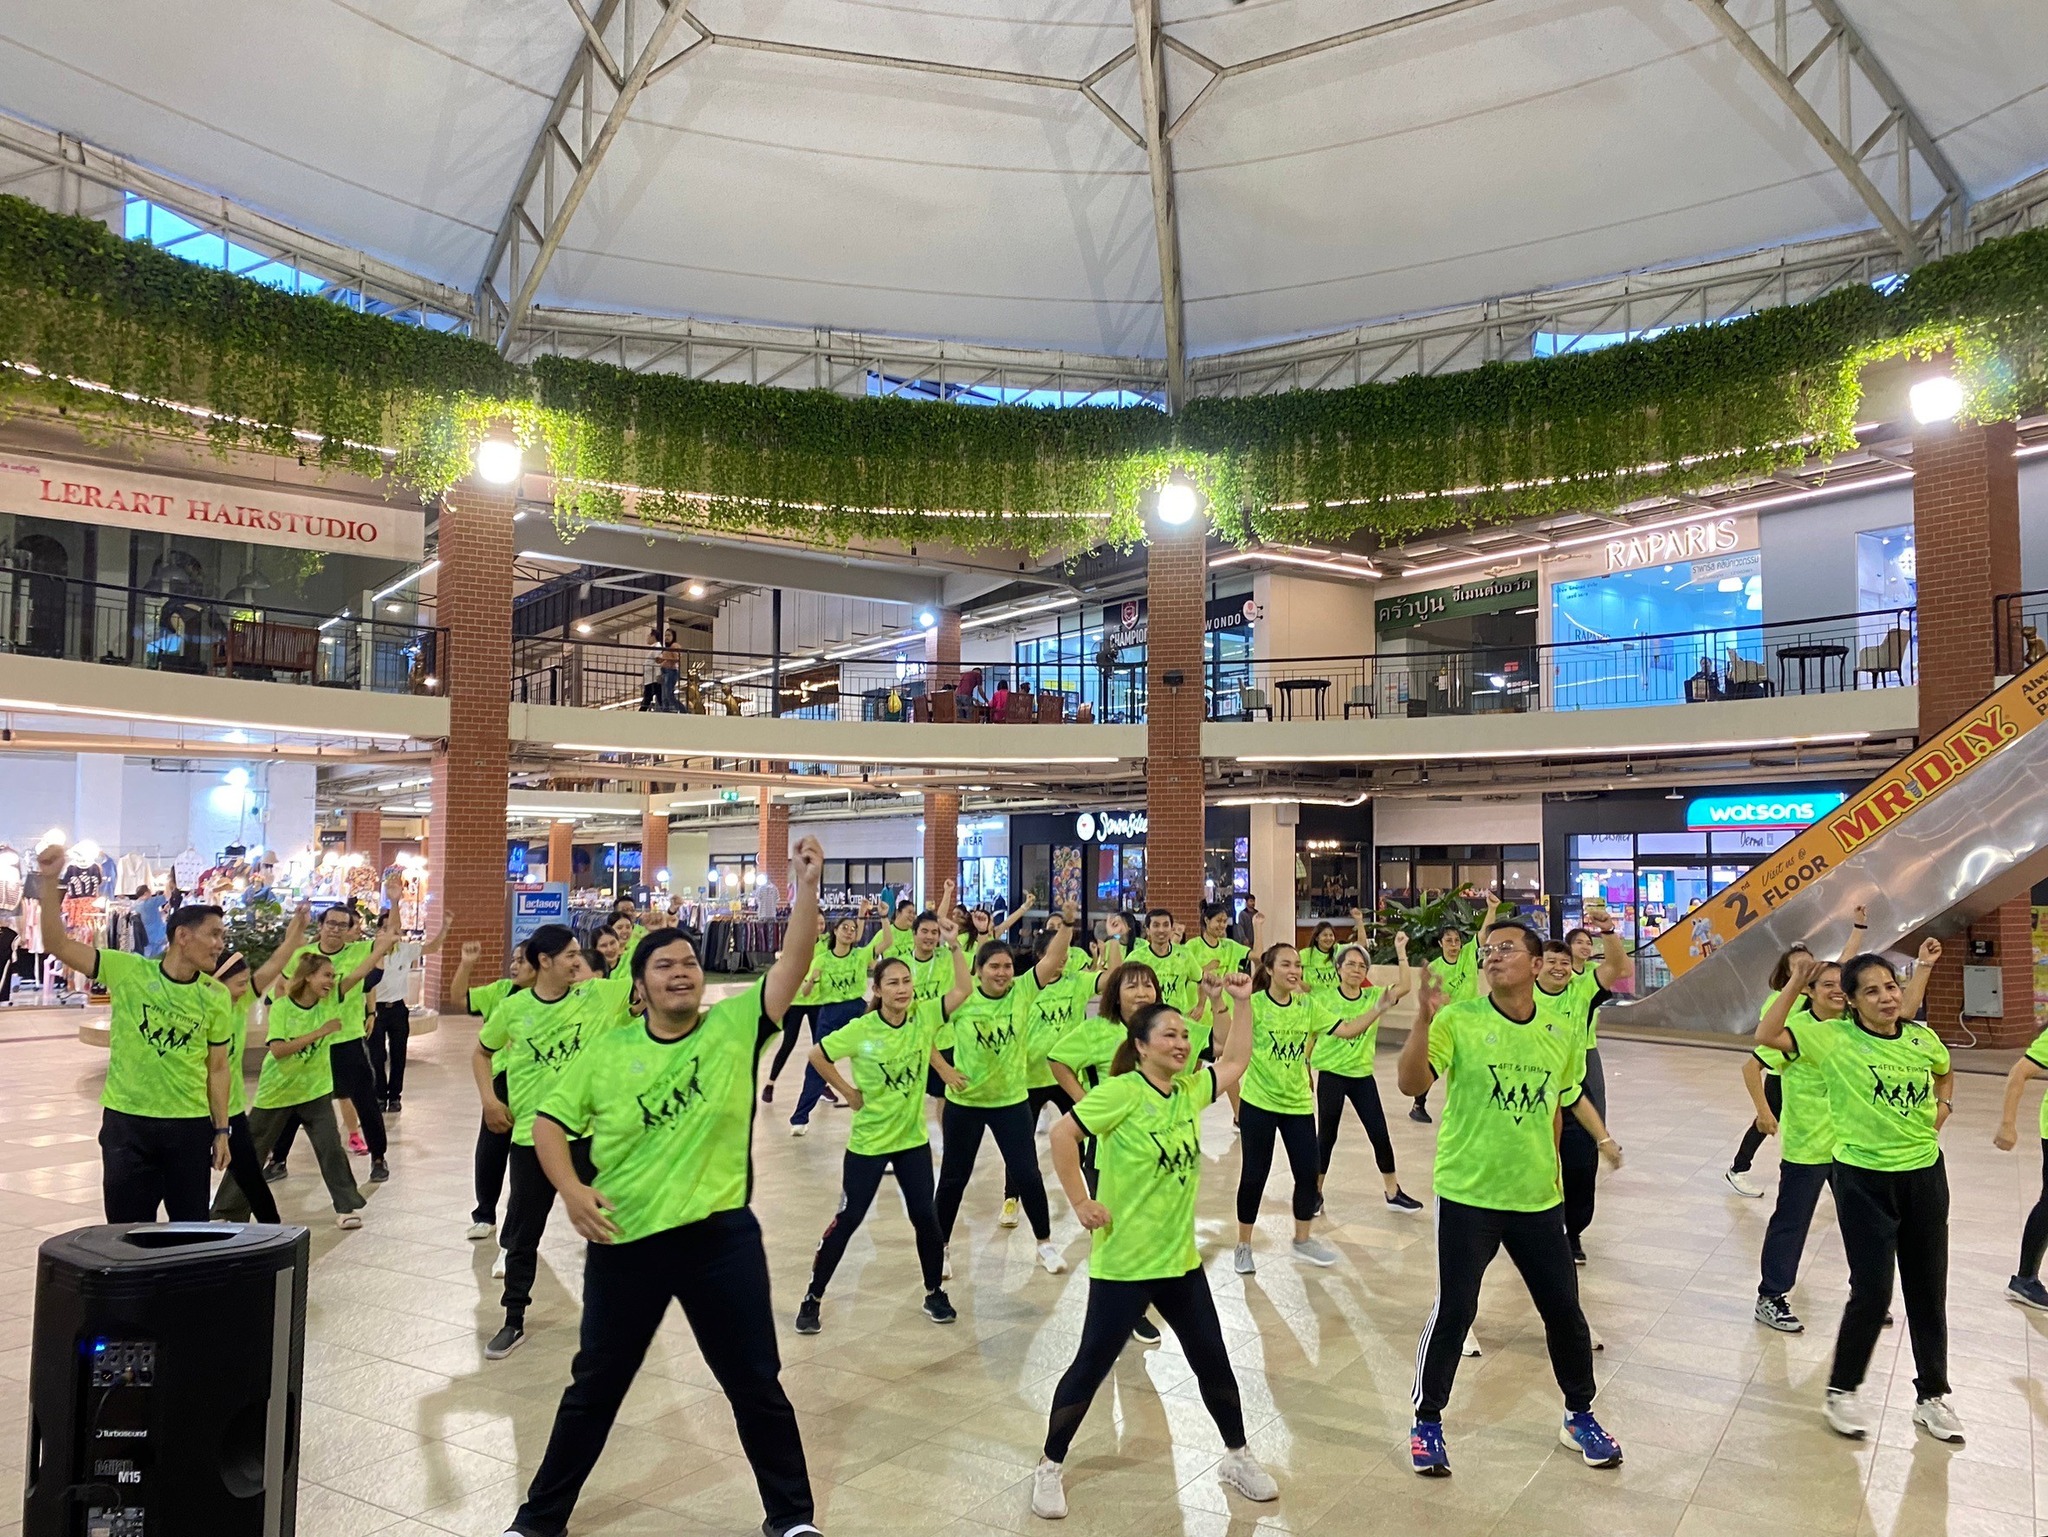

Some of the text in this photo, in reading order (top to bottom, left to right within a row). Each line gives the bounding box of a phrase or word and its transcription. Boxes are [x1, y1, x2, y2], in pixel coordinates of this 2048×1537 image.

[39, 479, 378, 543] LERART HAIRSTUDIO
[1604, 518, 1739, 571] RAPARIS
[1379, 595, 1446, 621] ครัวปูน
[1709, 802, 1815, 822] watsons
[1761, 860, 1785, 887] Visit
[1782, 857, 1795, 873] us
[1762, 854, 1829, 908] FLOOR
[519, 894, 561, 914] Lactasoy
[102, 1429, 148, 1438] Turbosound
[118, 1470, 141, 1483] M15
